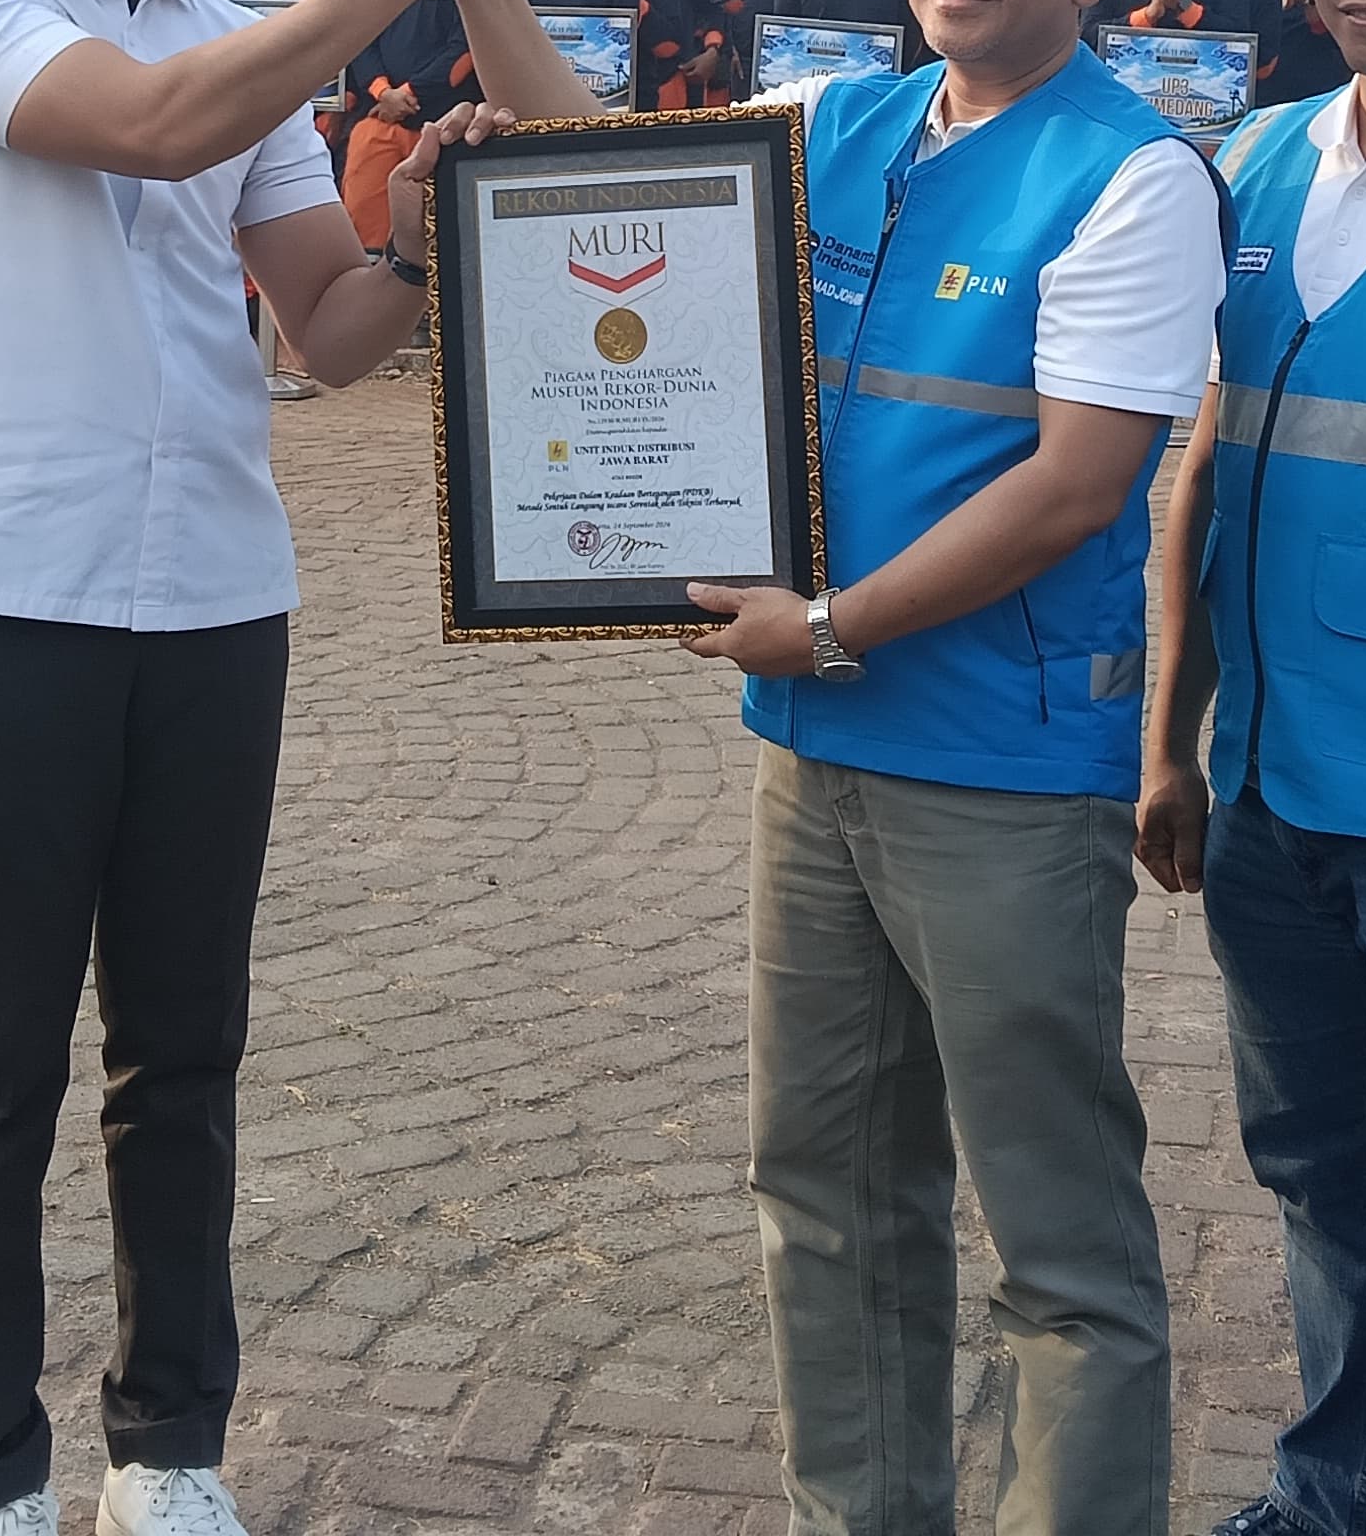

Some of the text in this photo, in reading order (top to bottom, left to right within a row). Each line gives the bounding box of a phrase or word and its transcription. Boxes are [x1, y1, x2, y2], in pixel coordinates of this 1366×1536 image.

[1162, 77, 1190, 95] UP3
[496, 179, 733, 214] REKOR INDONESIA
[568, 221, 666, 258] MURI
[816, 249, 872, 279] Indones
[966, 275, 1008, 297] PLN
[580, 396, 669, 412] INDONESIA
[599, 454, 670, 466] JAWA BARAT
